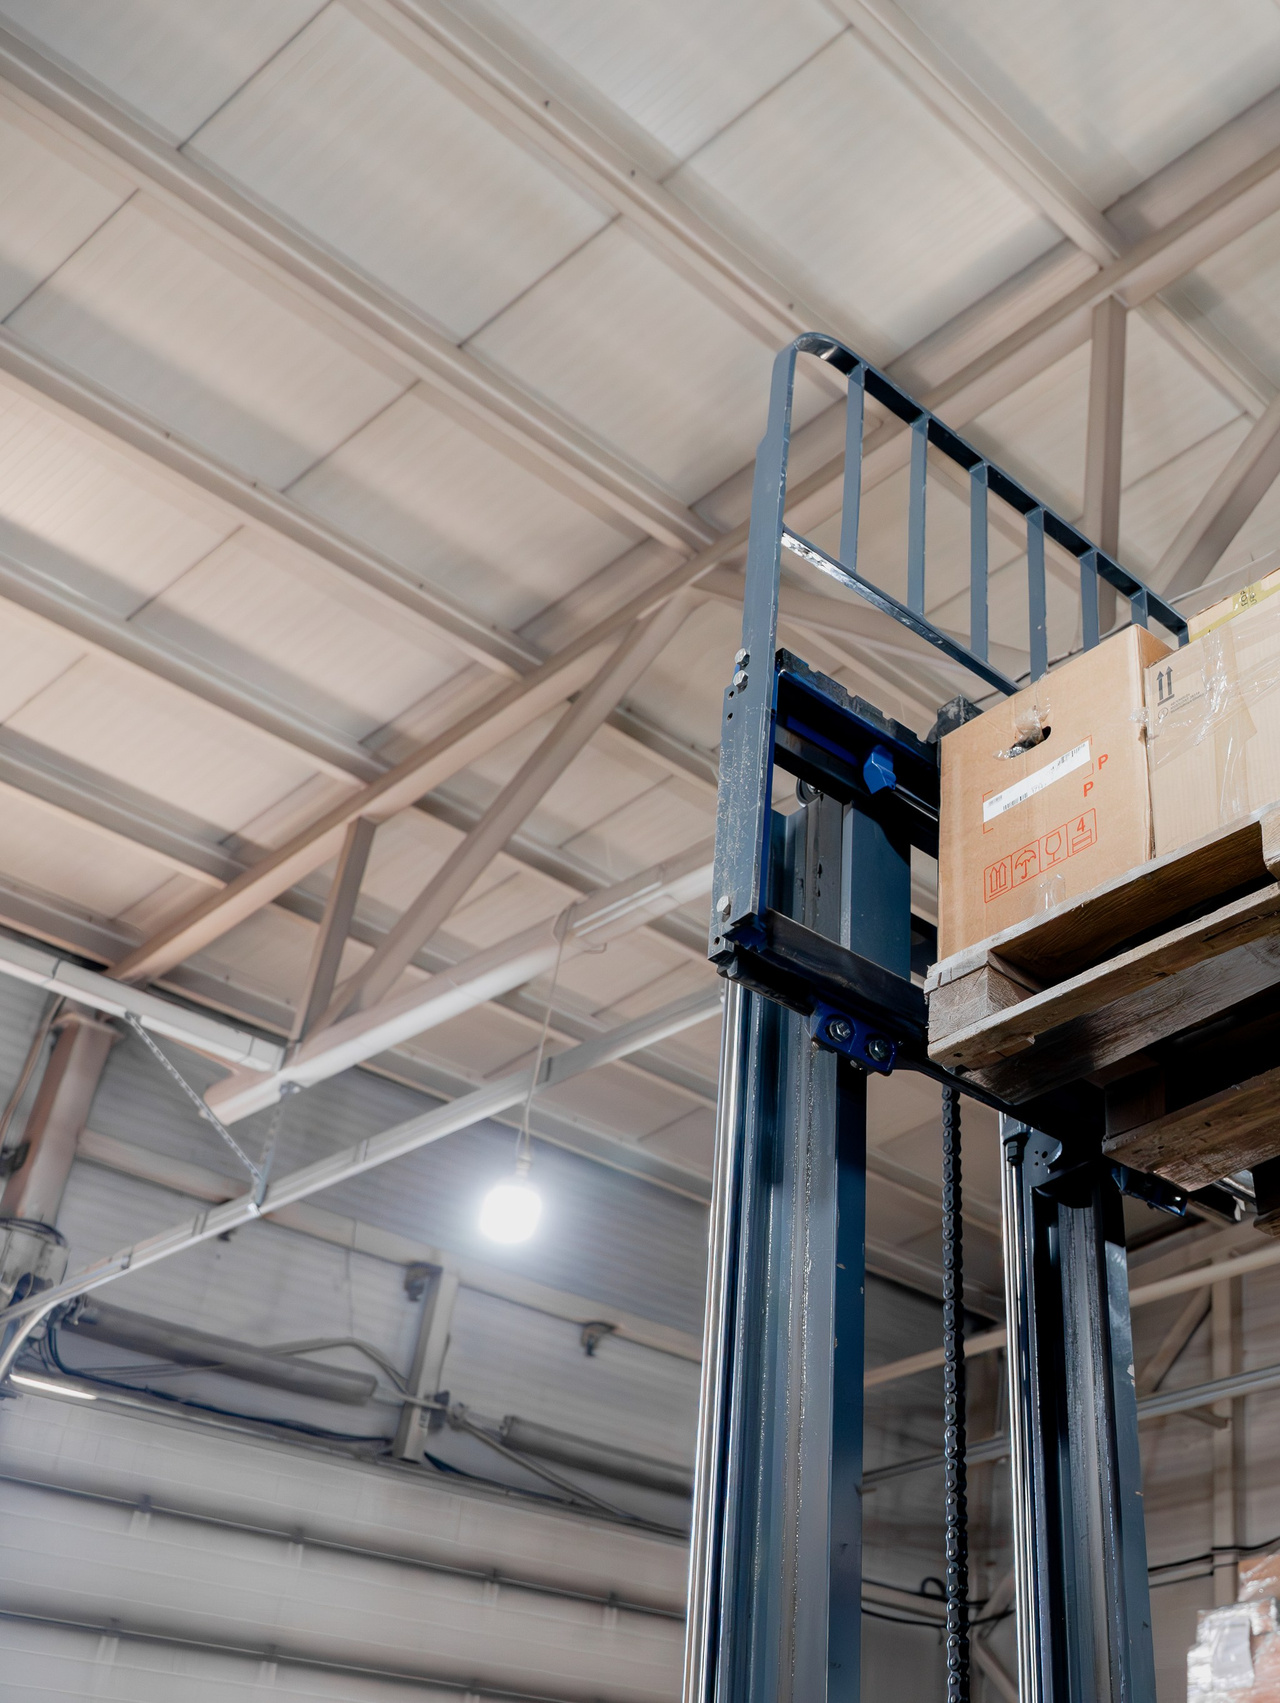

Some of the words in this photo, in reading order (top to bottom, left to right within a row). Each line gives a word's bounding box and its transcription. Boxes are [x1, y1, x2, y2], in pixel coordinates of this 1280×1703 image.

[1098, 753, 1108, 770] P
[1083, 781, 1094, 798] P
[1076, 816, 1086, 832] 4
